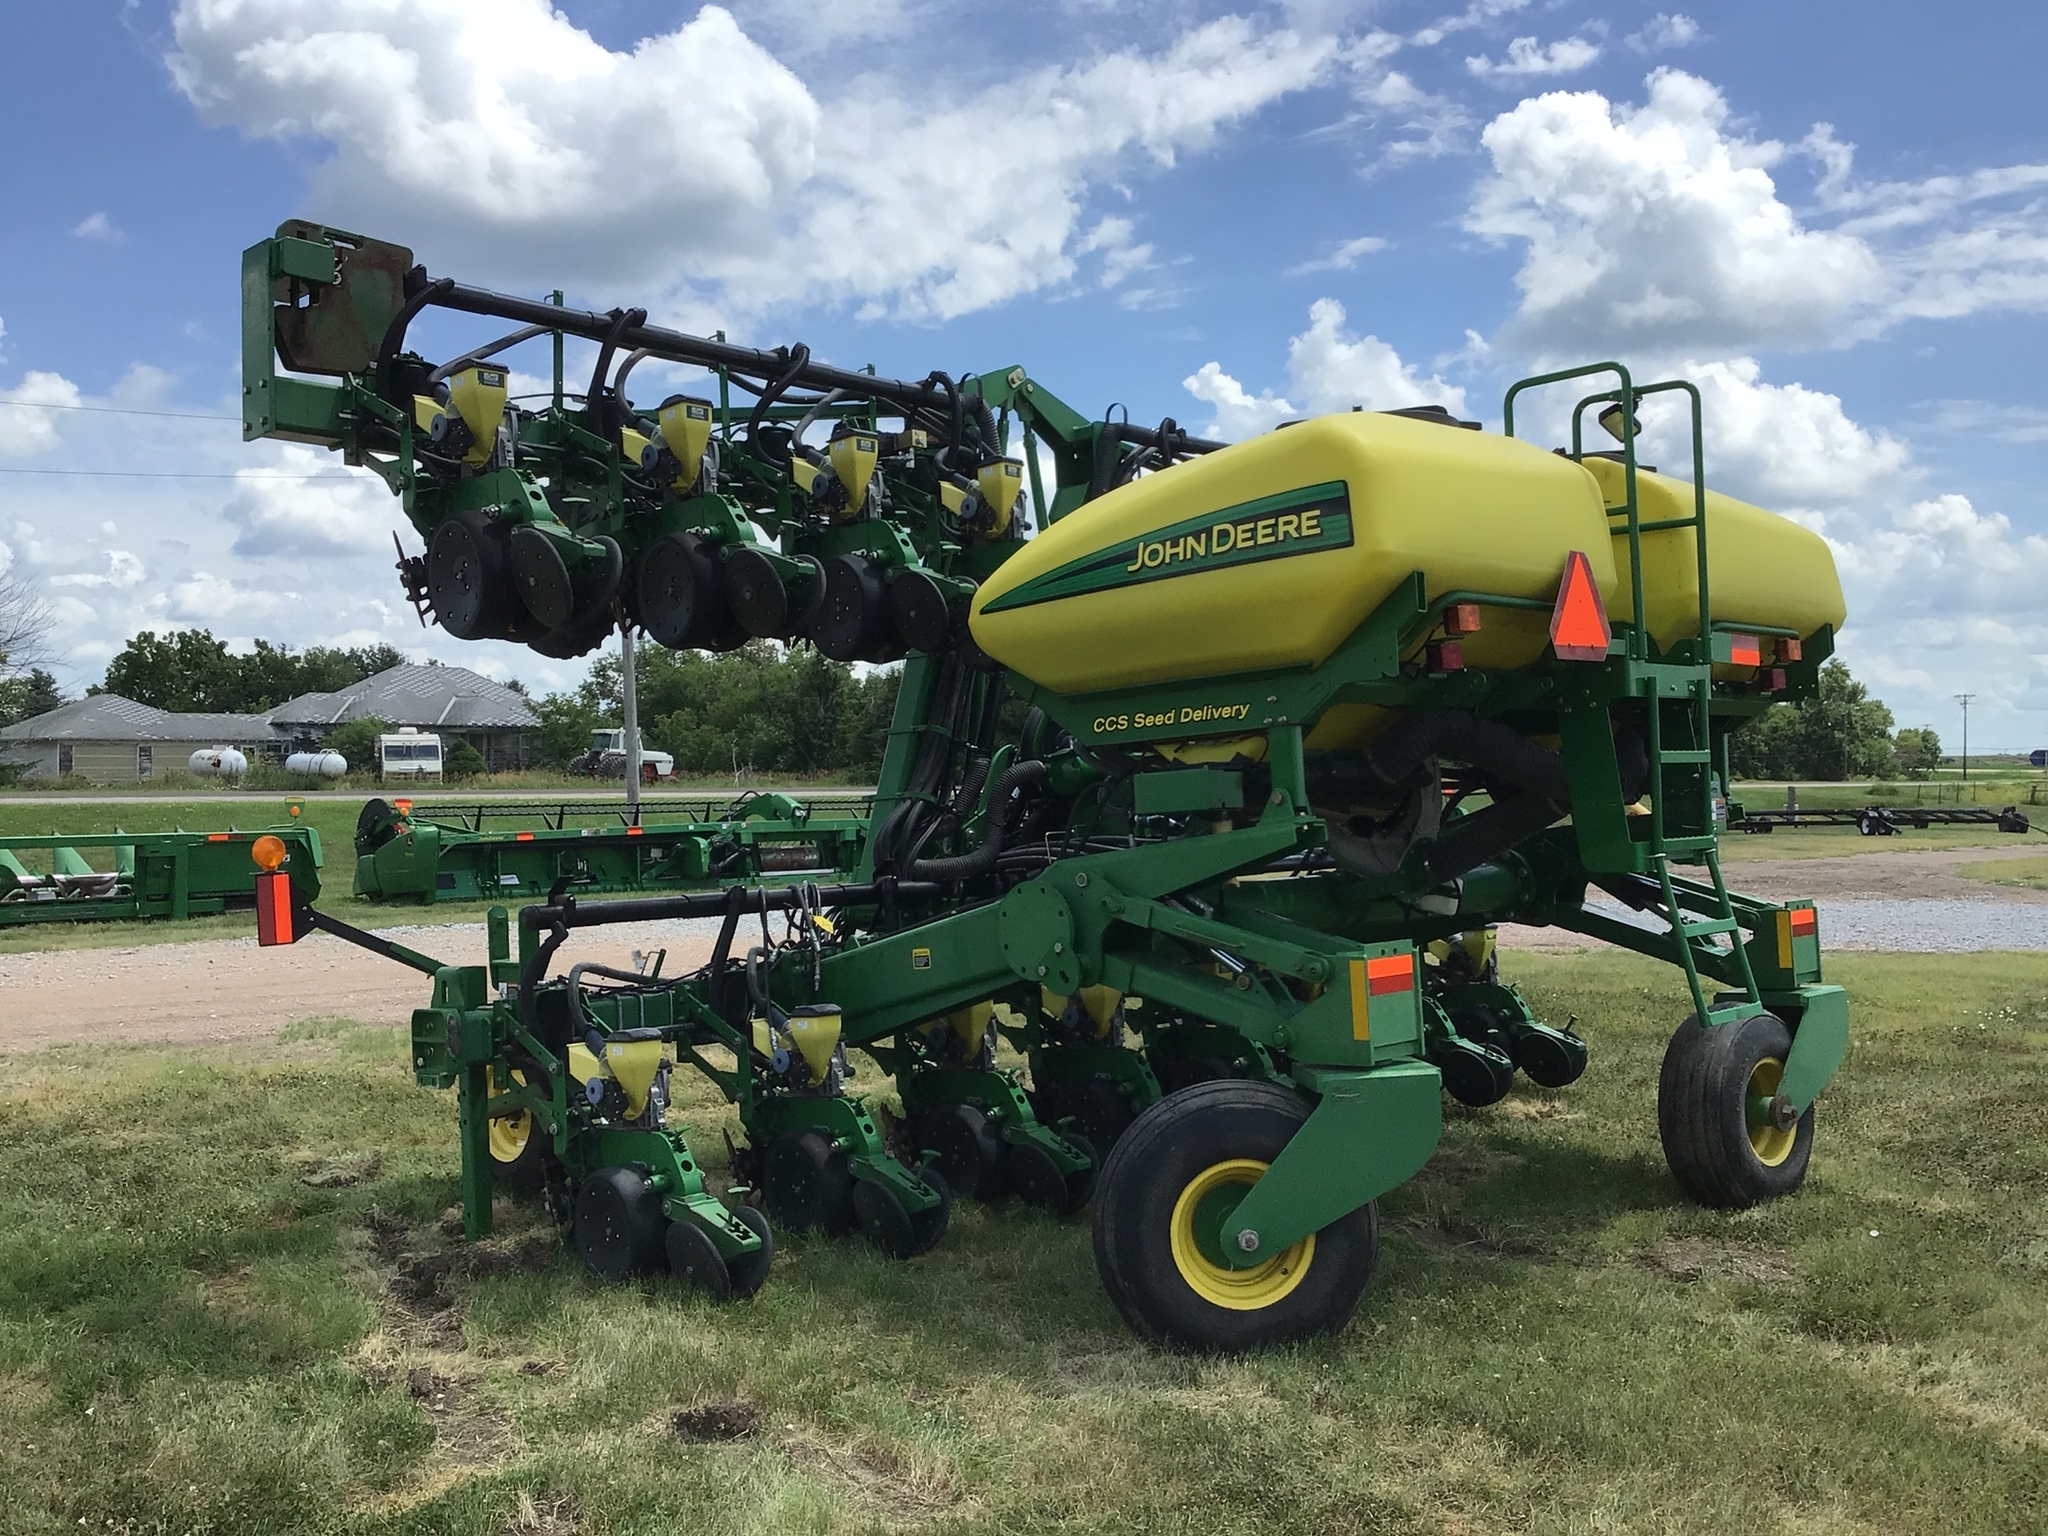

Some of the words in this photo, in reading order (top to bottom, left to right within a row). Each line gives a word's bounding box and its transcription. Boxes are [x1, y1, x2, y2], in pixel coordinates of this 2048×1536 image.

[1127, 533, 1206, 572] JOHN
[1212, 510, 1321, 554] DEERE
[1093, 715, 1129, 733] CCS
[1133, 709, 1175, 728] Seed
[1180, 703, 1250, 723] Delivery
